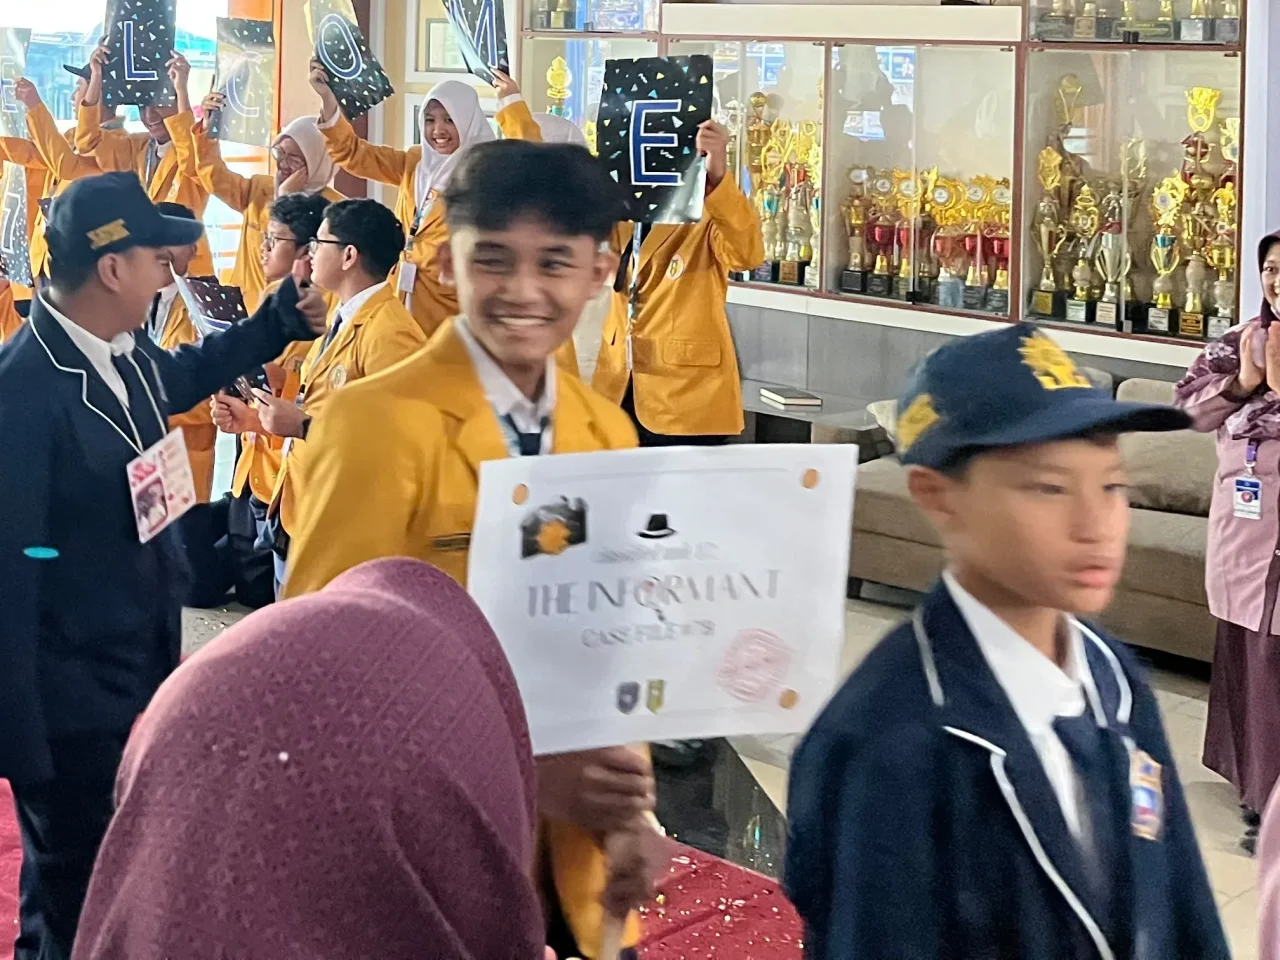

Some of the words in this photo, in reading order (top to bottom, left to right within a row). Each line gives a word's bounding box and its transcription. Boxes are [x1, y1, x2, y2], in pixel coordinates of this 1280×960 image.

[124, 20, 158, 81] L
[317, 13, 363, 80] O
[226, 51, 263, 118] C
[629, 99, 685, 186] E
[528, 581, 579, 618] THE
[587, 569, 782, 612] INFORMANT
